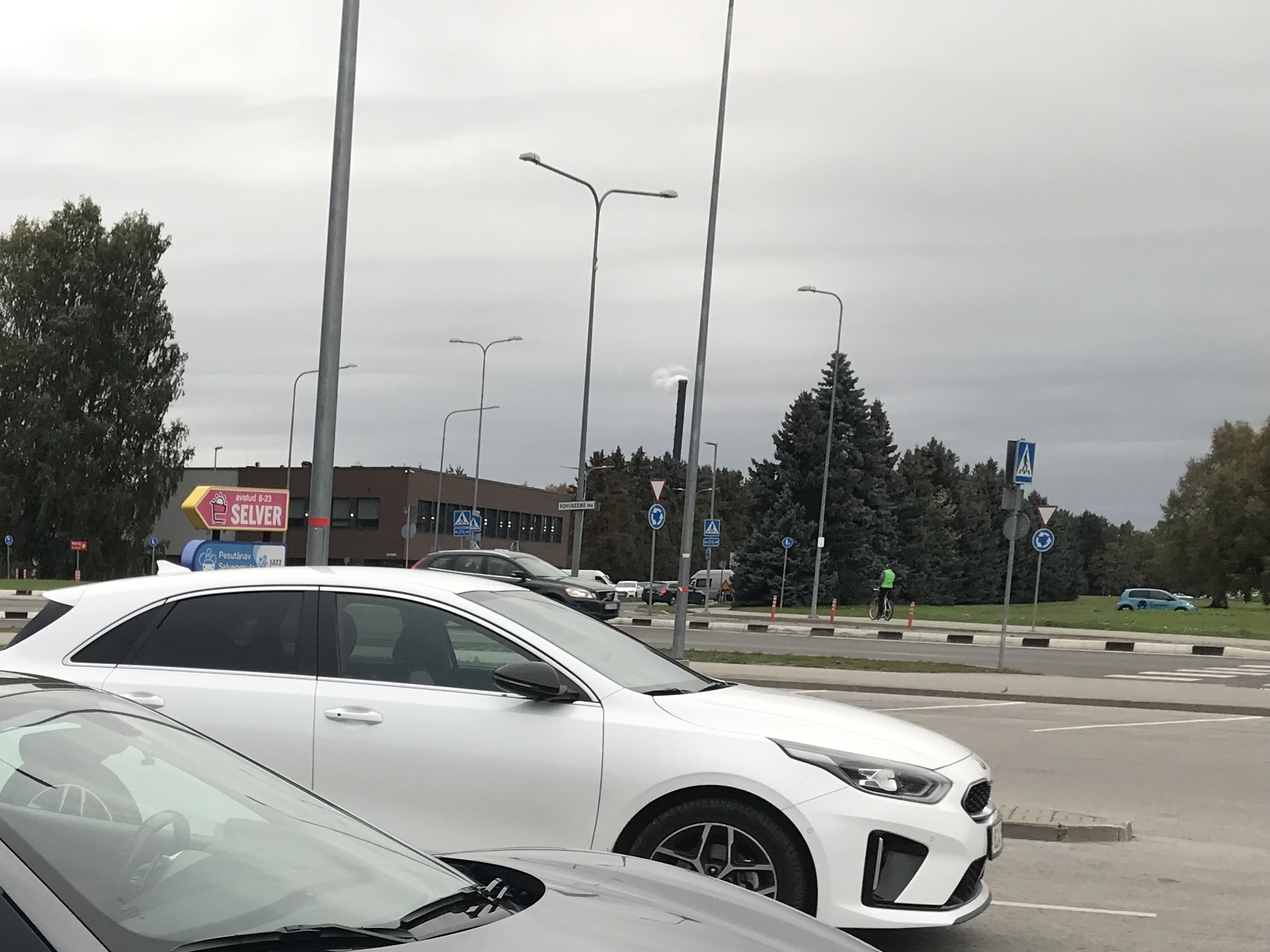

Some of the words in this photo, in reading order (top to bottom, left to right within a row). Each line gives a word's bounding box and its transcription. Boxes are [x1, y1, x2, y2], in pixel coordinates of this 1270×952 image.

[235, 493, 257, 502] avatud
[258, 494, 272, 503] 8-23
[230, 503, 282, 526] SELVER
